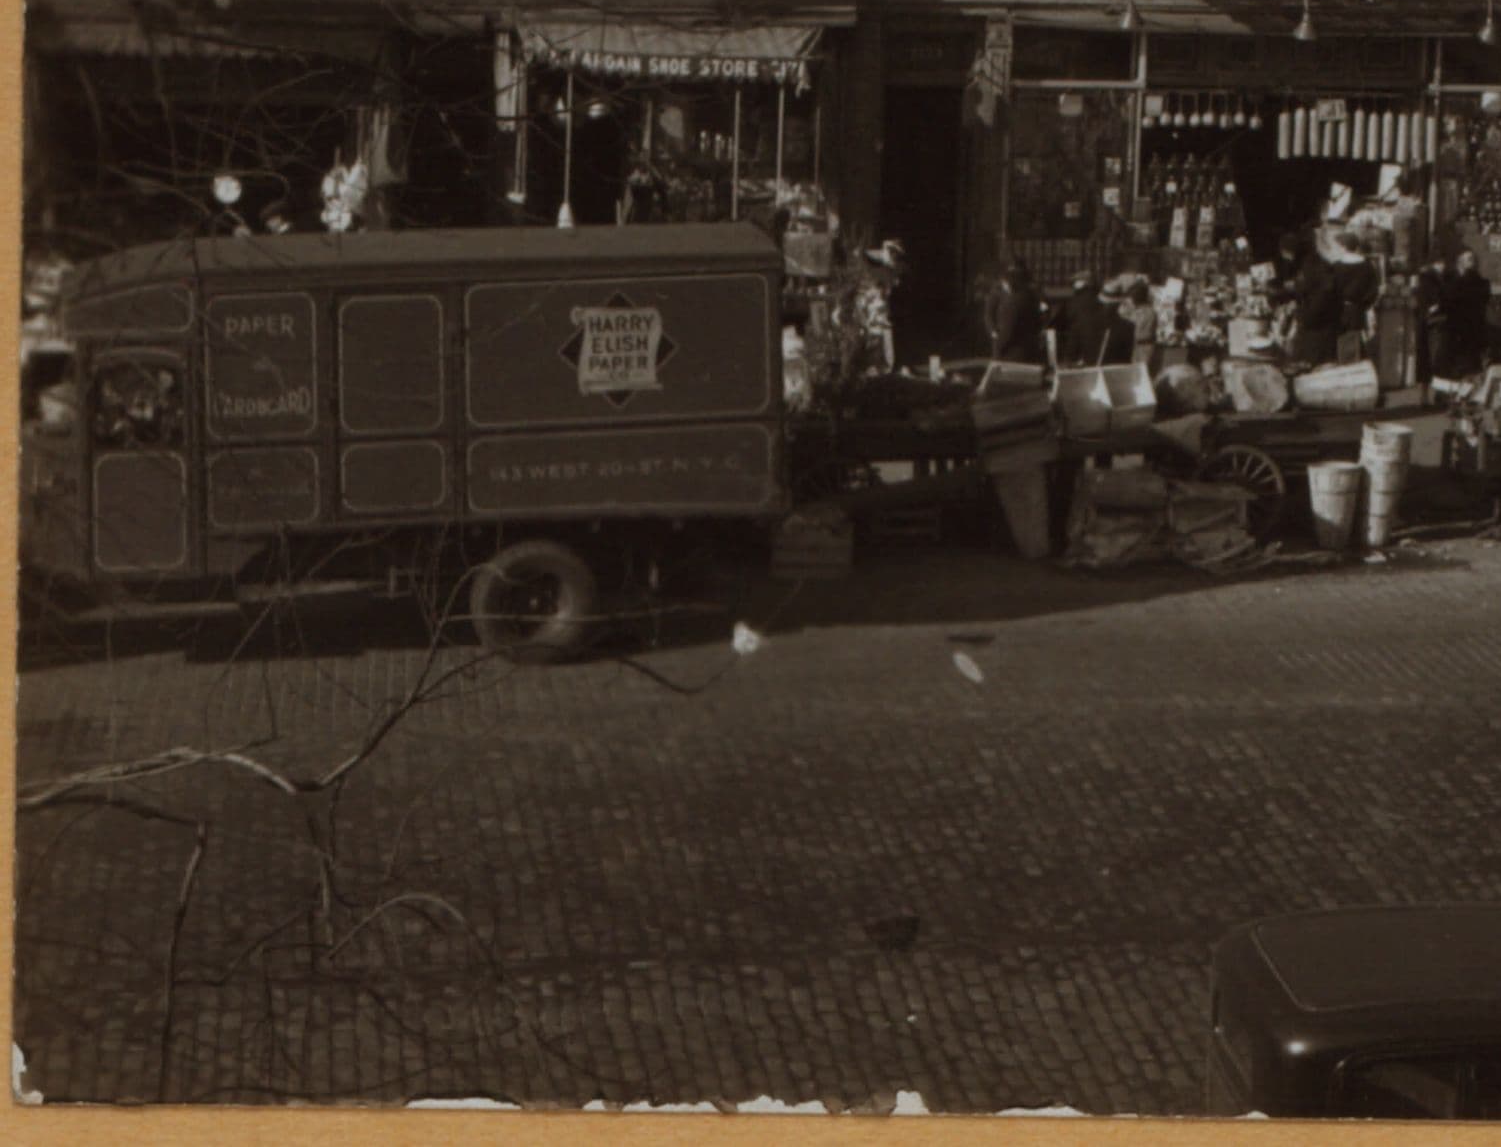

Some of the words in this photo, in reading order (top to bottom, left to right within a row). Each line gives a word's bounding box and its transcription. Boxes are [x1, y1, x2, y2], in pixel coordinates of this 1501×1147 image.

[648, 56, 691, 76] SHOE
[699, 57, 759, 79] STORE
[224, 313, 296, 339] PAPER
[588, 314, 654, 333] HARRY
[591, 335, 649, 354] ELISH
[588, 355, 649, 372] PAPER
